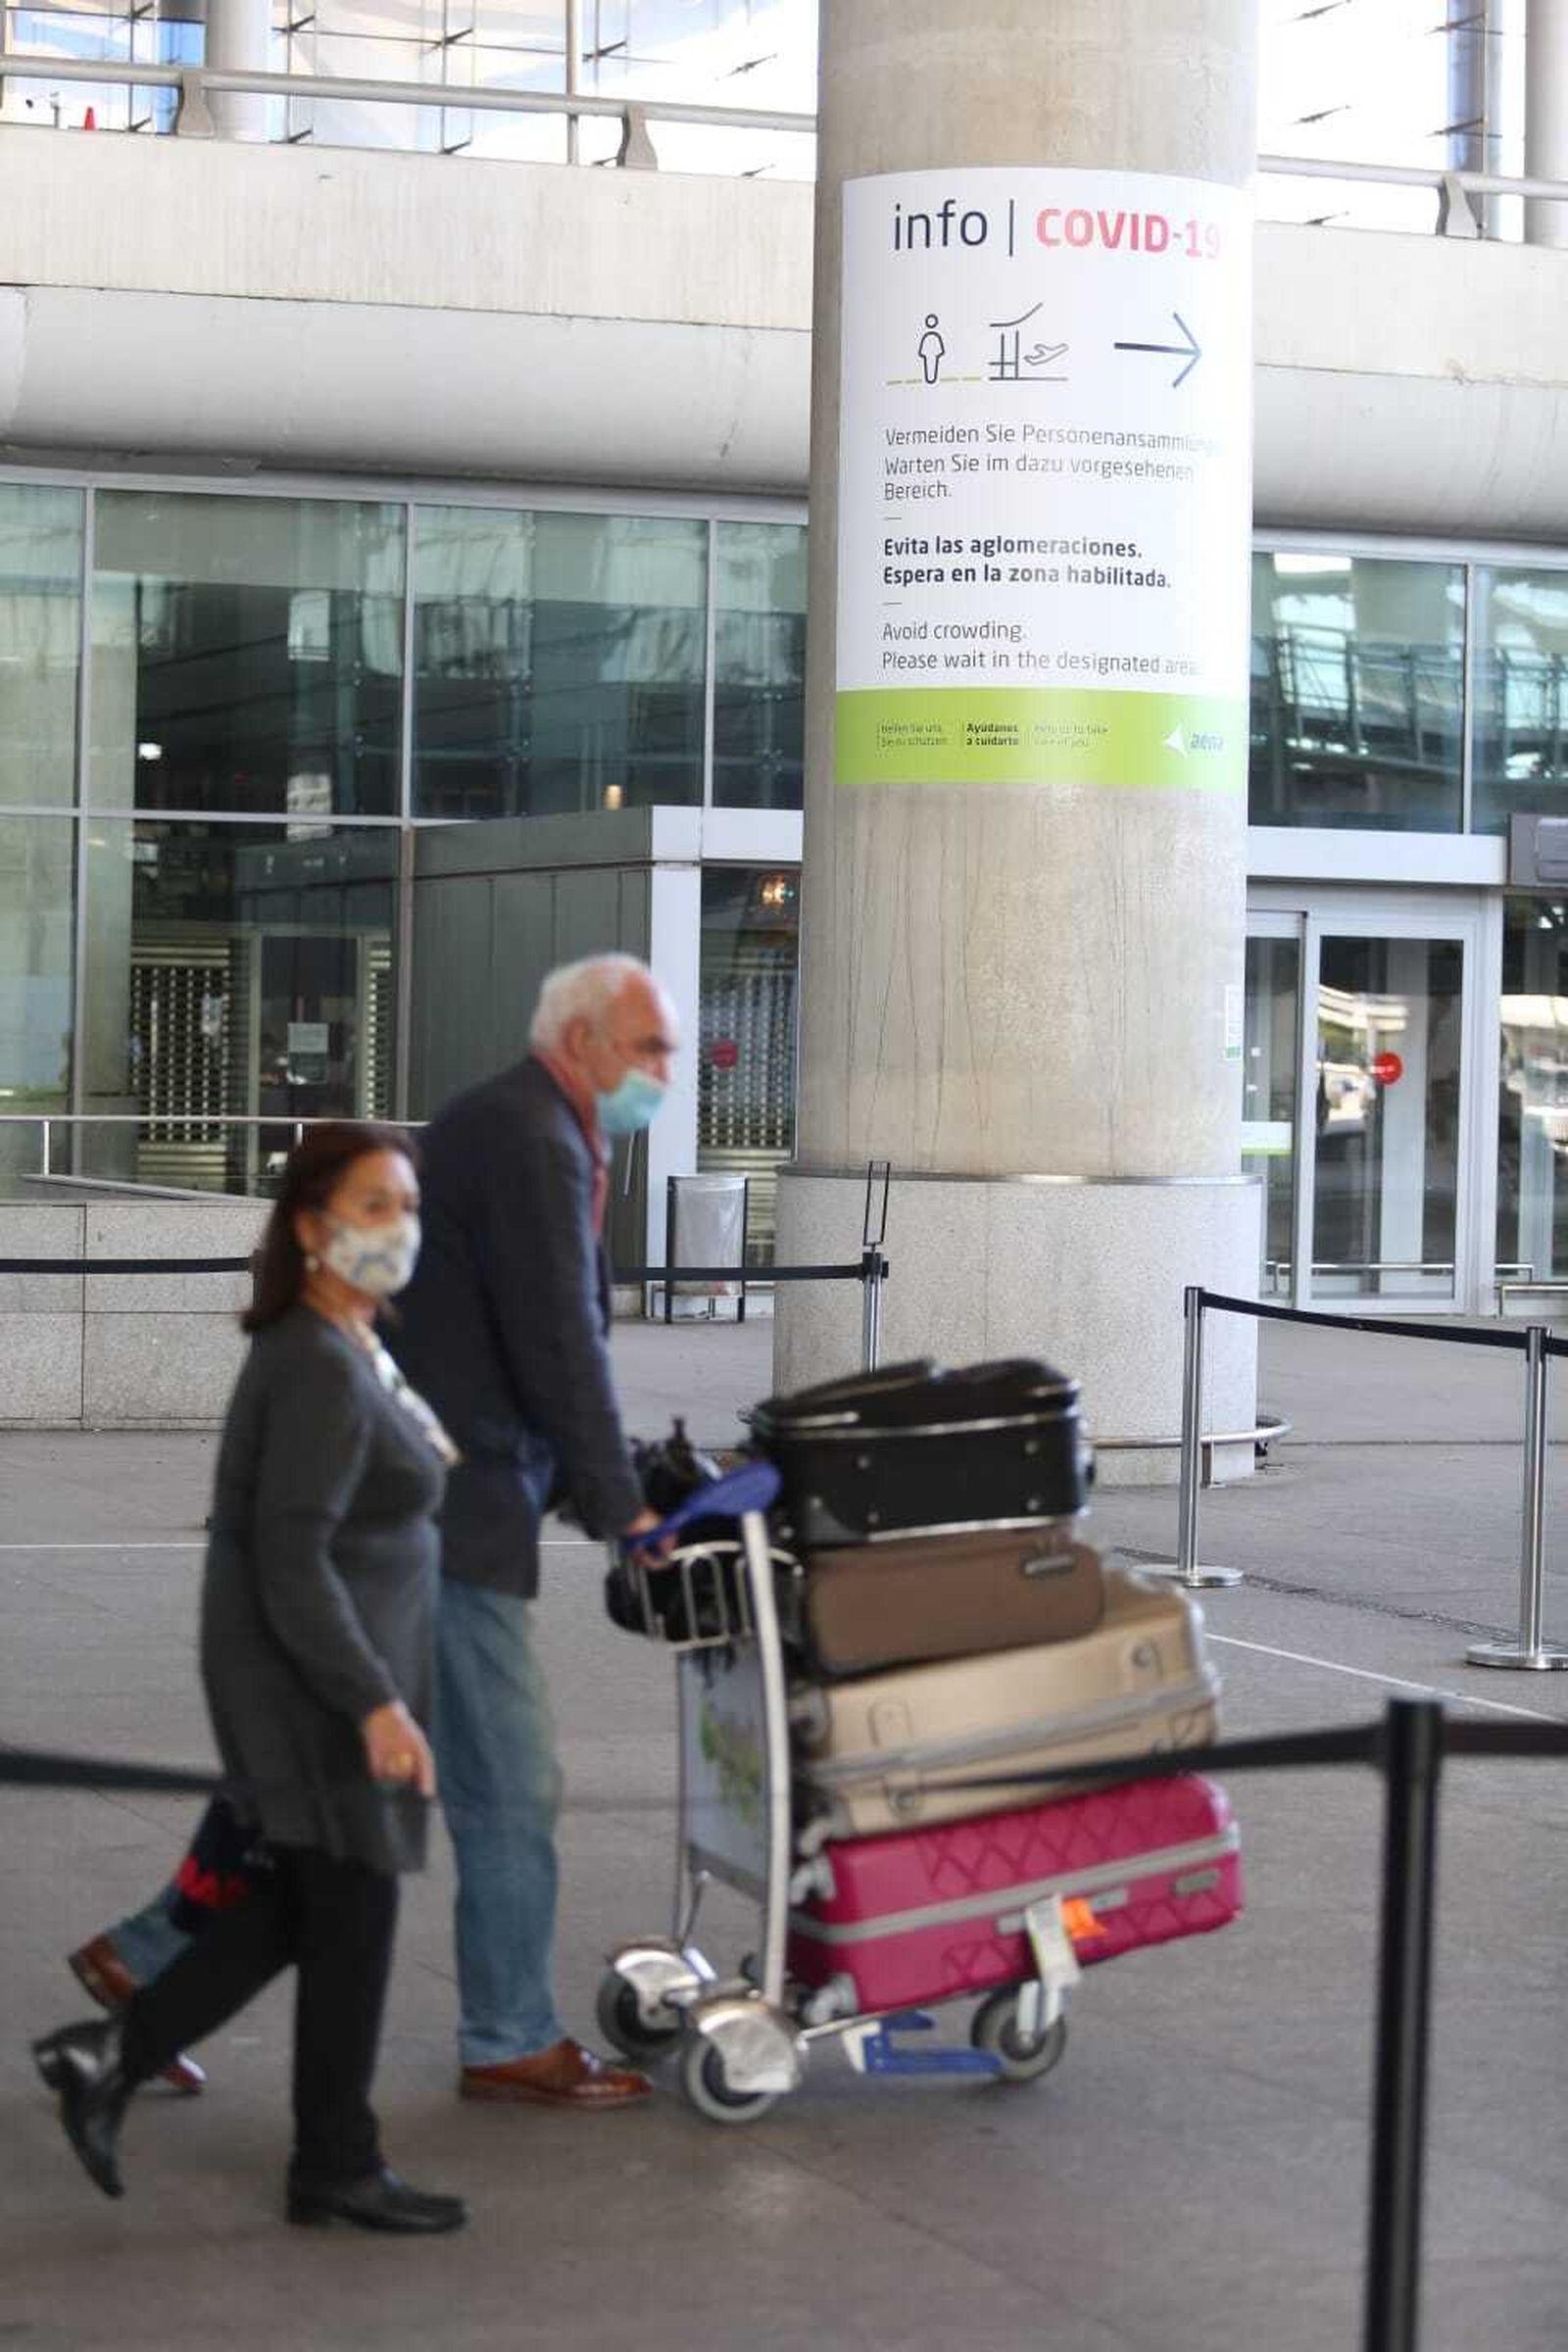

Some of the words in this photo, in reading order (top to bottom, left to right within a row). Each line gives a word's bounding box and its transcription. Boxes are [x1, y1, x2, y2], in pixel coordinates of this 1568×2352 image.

[894, 199, 988, 250] info
[1036, 207, 1221, 259] COVID-19
[886, 425, 979, 445] Vermeiden
[986, 424, 1015, 442] Sie
[885, 456, 945, 475] Warten
[952, 454, 979, 471] Sie
[987, 454, 1008, 470] im
[1015, 453, 1062, 471] dazu
[884, 480, 952, 500] Bereich.
[884, 537, 928, 556] Evita
[936, 535, 962, 554] las
[970, 535, 1142, 558] aglomeraciones.
[884, 565, 944, 587] Espera
[952, 567, 976, 582] en
[984, 564, 1002, 582] la
[1008, 566, 1059, 582] zona
[1067, 564, 1170, 588] habilitada.
[882, 620, 927, 640] Avoid
[934, 620, 1026, 643] crowding.
[882, 651, 937, 669] Please
[944, 649, 987, 667] wait
[992, 650, 1009, 667] in
[1017, 651, 1050, 668] the
[1056, 651, 1160, 675] designated
